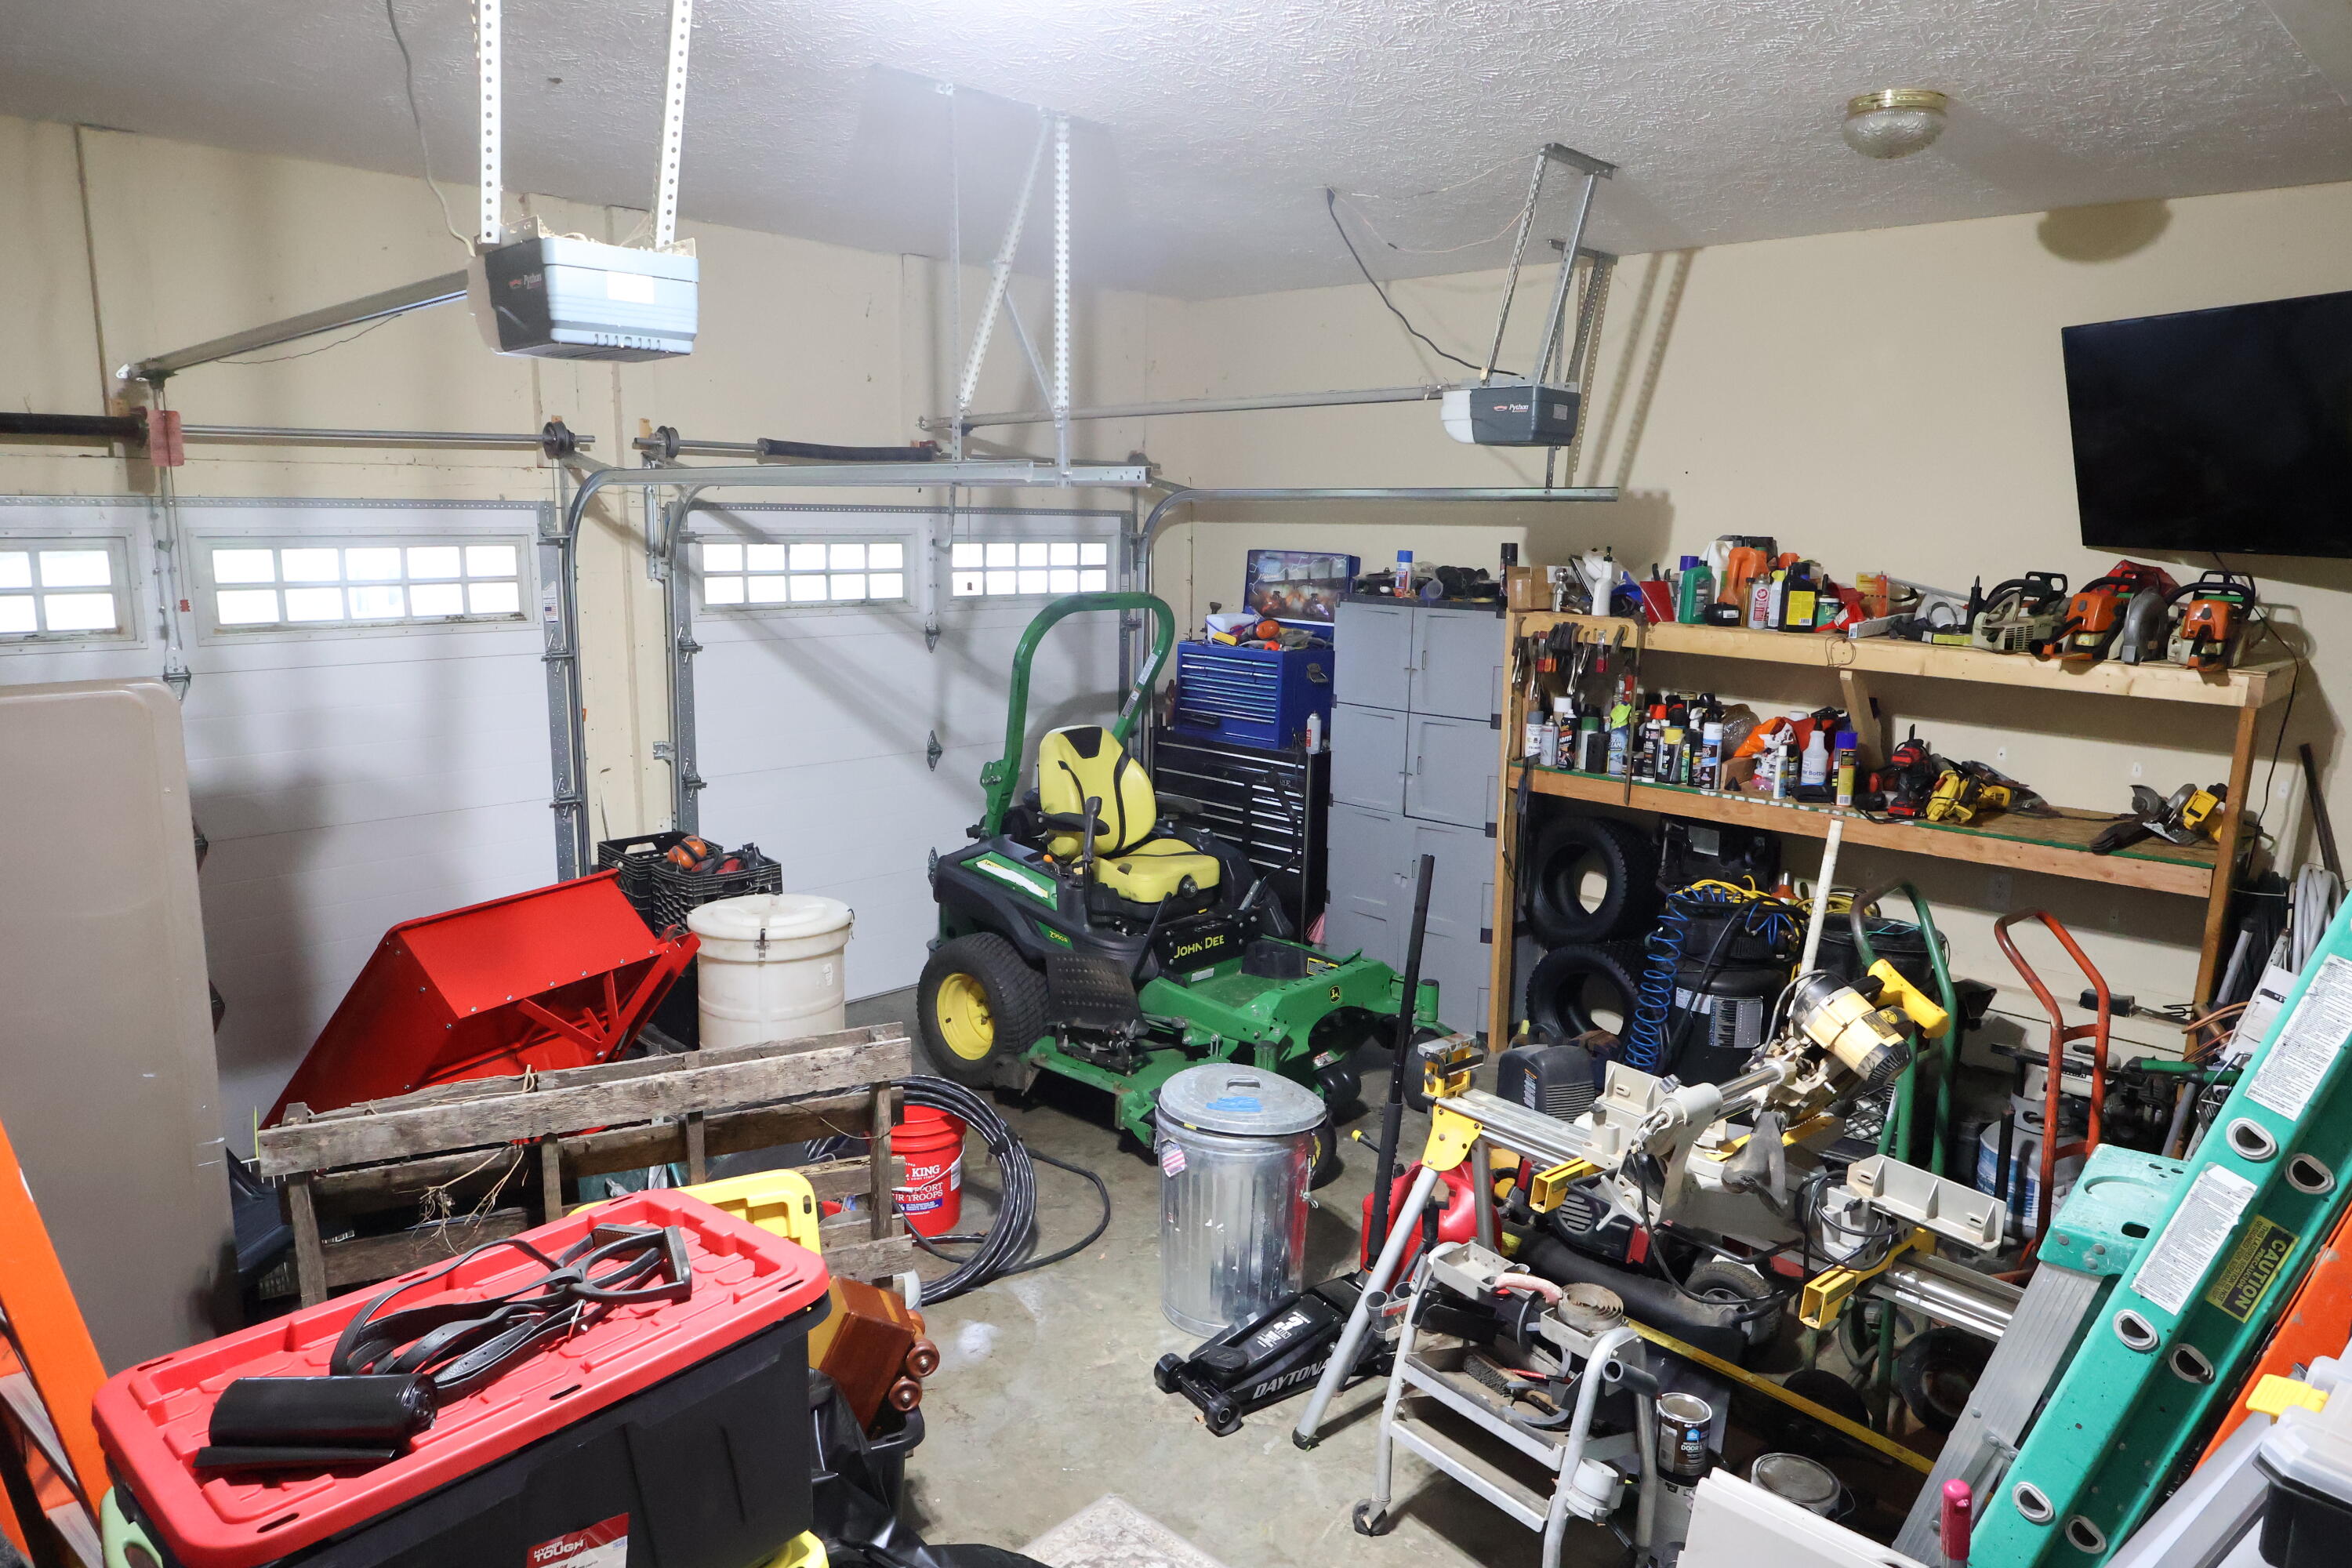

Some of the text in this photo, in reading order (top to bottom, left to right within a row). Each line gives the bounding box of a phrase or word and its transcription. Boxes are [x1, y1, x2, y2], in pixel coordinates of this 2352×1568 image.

[1509, 404, 1529, 413] Python
[1174, 935, 1225, 959] JOHN DEE
[912, 1165, 941, 1178] KING
[906, 1189, 943, 1202] TROOPS
[2256, 1225, 2268, 1239] THIS
[2234, 1239, 2287, 1310] CAUTION
[2216, 1289, 2227, 1302] NOT
[1252, 1357, 1332, 1400] DAYTONA
[534, 1541, 563, 1555] HYPER
[534, 1539, 584, 1563] TOUGH
